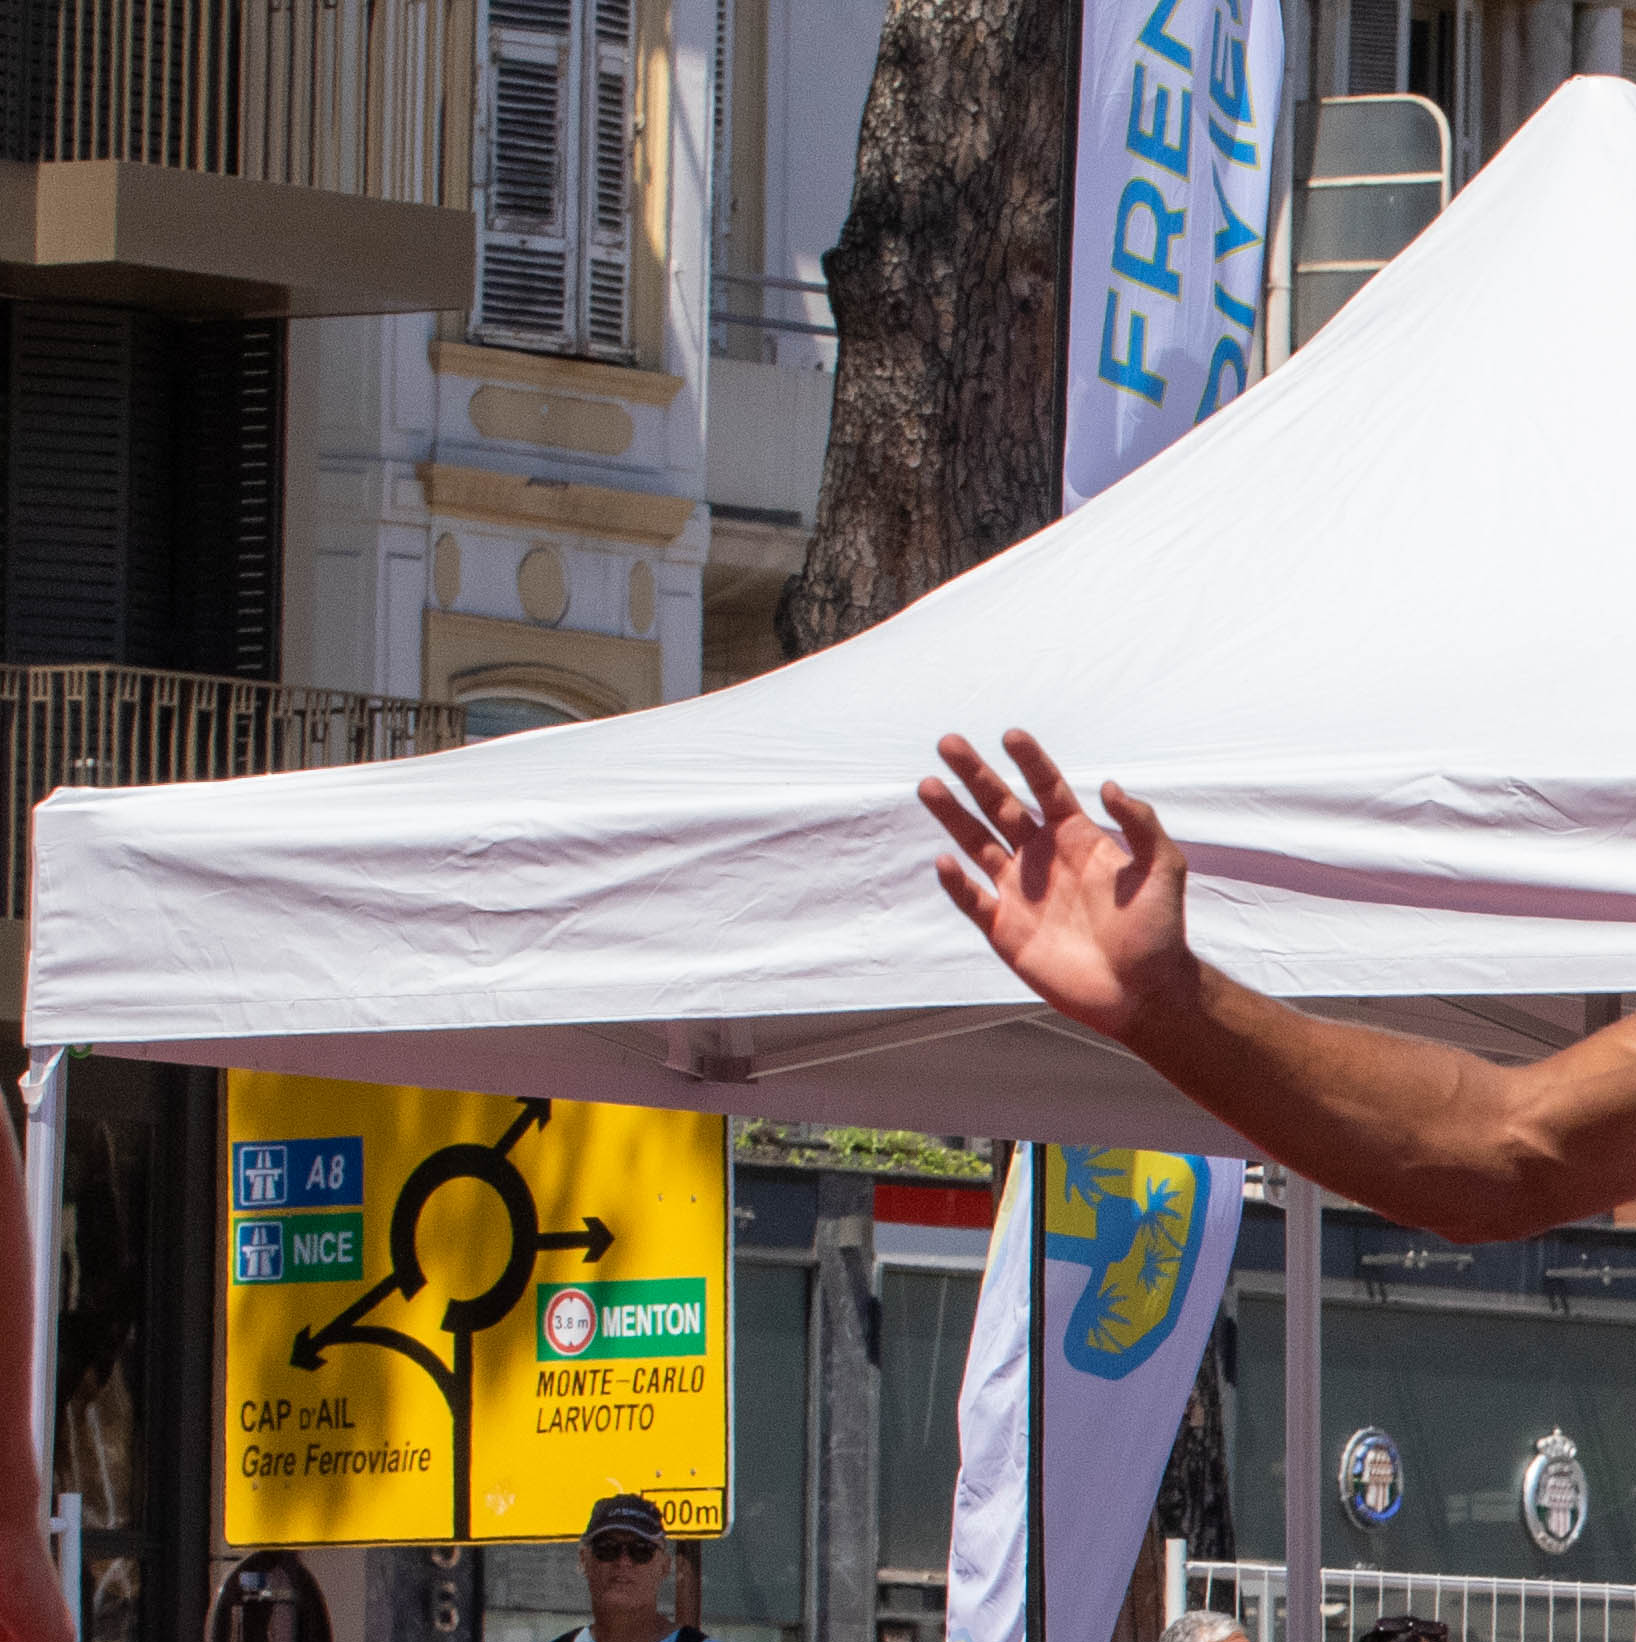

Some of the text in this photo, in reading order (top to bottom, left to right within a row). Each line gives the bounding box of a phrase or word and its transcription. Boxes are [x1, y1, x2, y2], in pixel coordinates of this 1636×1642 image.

[305, 1153, 345, 1190] A8
[293, 1231, 354, 1265] NICE
[602, 1302, 701, 1338] MENTON
[241, 1399, 292, 1432] CAP
[536, 1403, 655, 1434] LARVOTTO
[242, 1440, 431, 1478] Gare Ferroviaire
[661, 1499, 719, 1526] 00m
